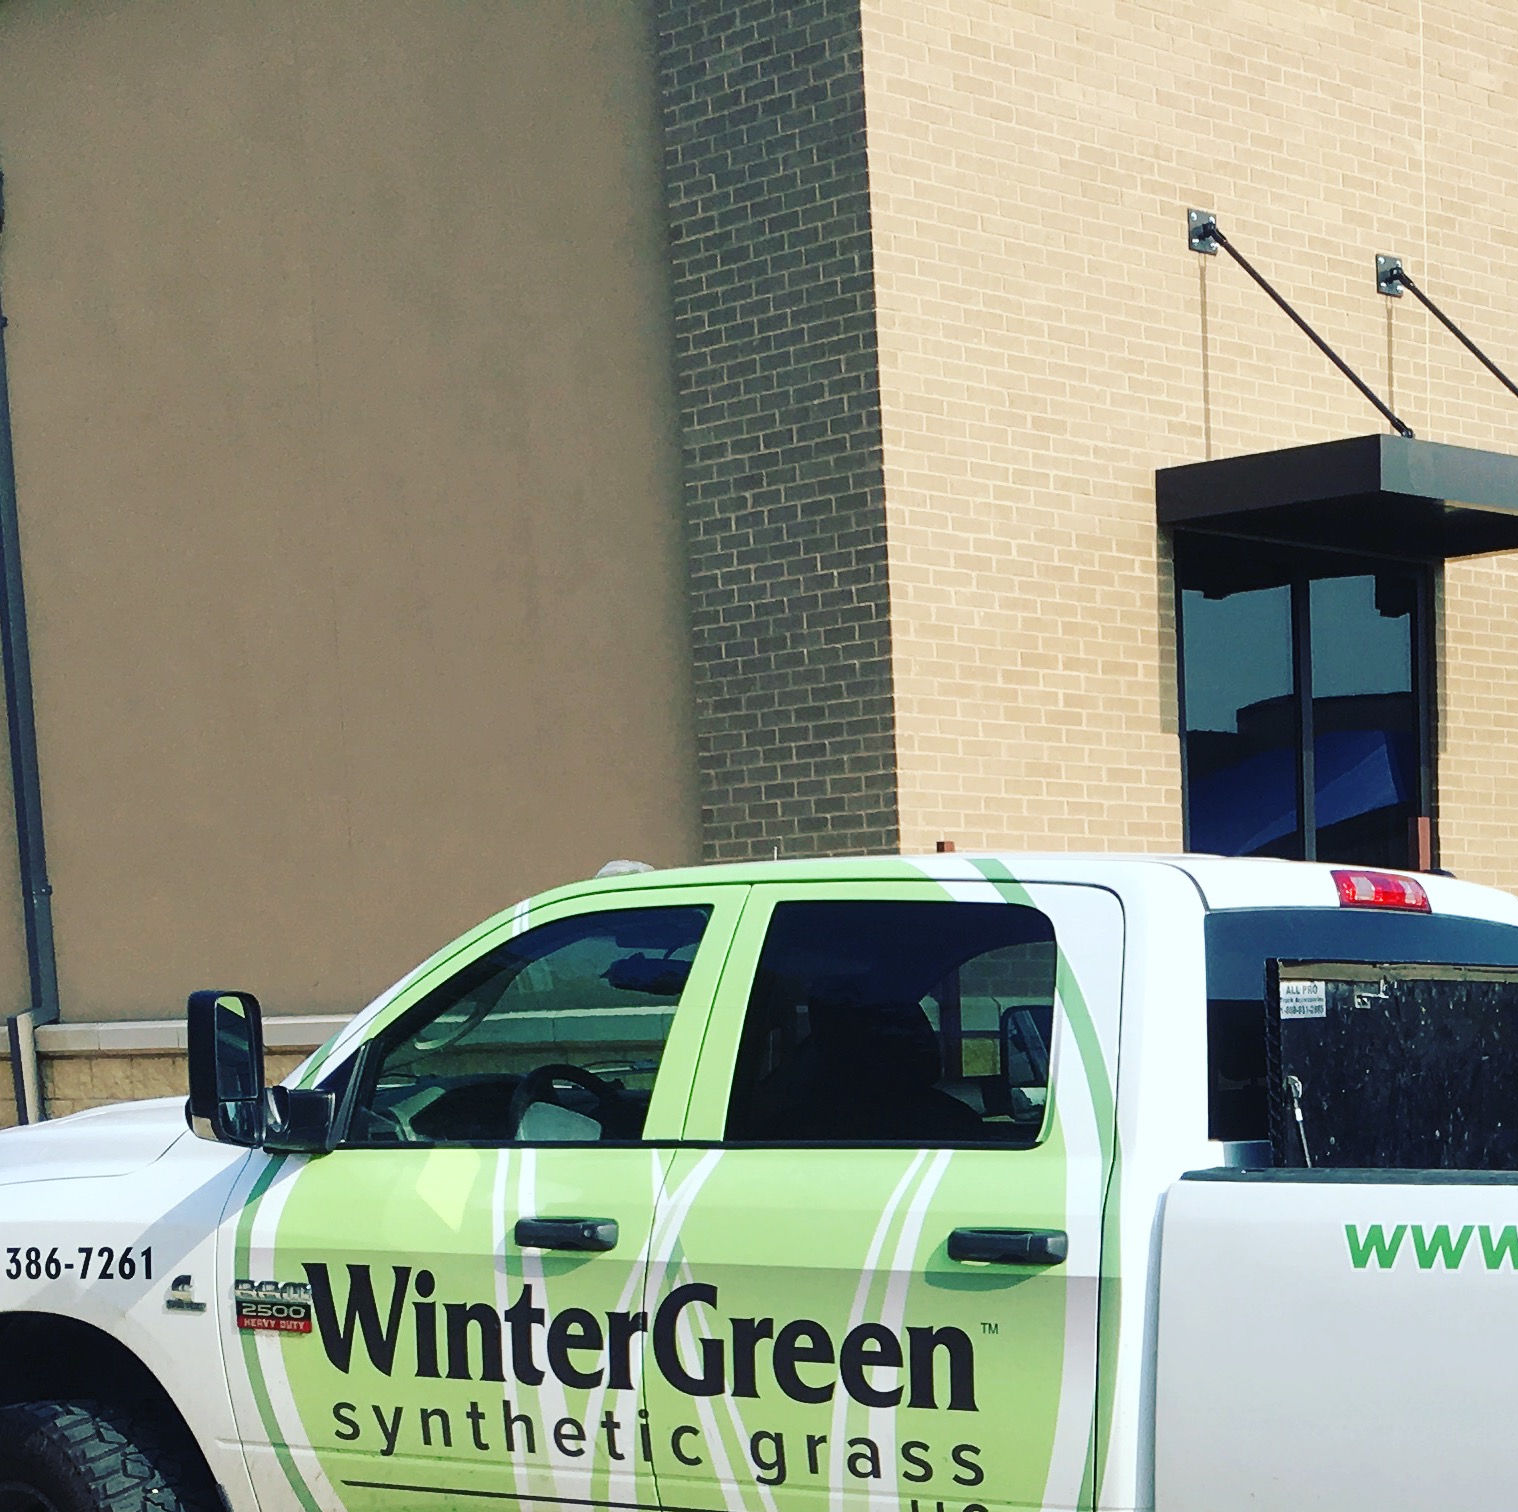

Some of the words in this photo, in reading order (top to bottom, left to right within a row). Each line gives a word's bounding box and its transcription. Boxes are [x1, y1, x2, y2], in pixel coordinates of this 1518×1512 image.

[1286, 986, 1300, 994] ALL
[5, 1246, 153, 1280] 386-7261
[242, 1302, 306, 1319] 2500
[244, 1317, 276, 1328] HEAVY
[279, 1319, 305, 1330] DUTY
[301, 1262, 980, 1412] WinterGreen
[332, 1400, 703, 1466] synthetic
[750, 1428, 985, 1487] grass
